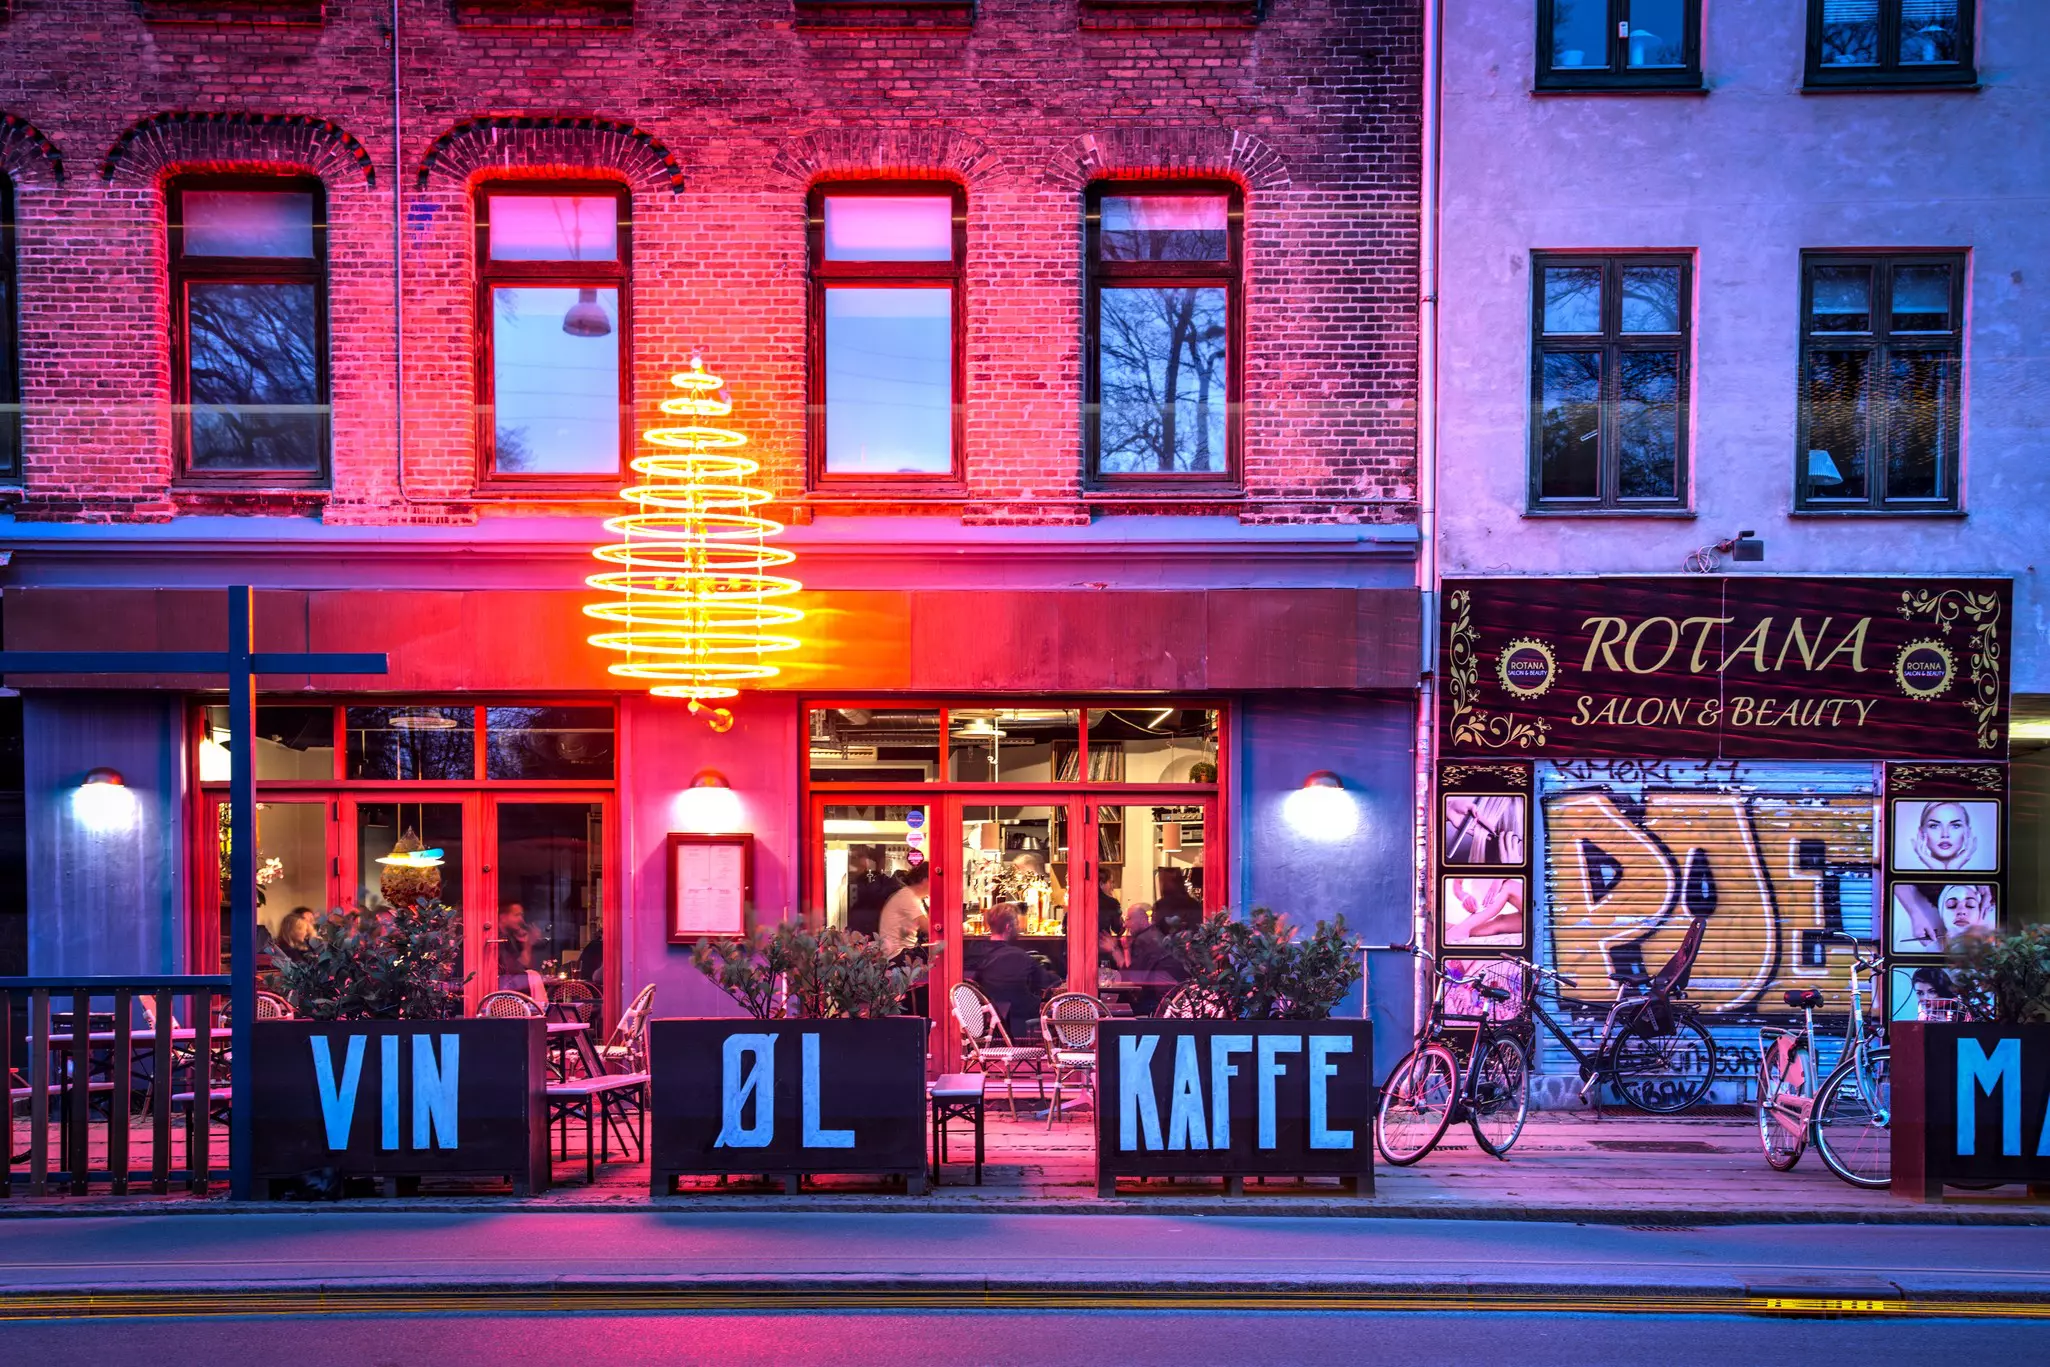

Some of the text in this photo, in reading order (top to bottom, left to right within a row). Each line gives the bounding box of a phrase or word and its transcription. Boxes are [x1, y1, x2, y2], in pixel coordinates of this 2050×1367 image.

[1510, 661, 1545, 670] ROTANA
[1581, 616, 1873, 674] ROTANA
[1906, 662, 1942, 671] ROTANA
[1571, 695, 1878, 727] SALON & BEAUTY
[310, 1034, 460, 1151] VIN
[713, 1032, 856, 1149] ØL
[1119, 1034, 1355, 1151] KAFFE
[1957, 1037, 2050, 1157] M
